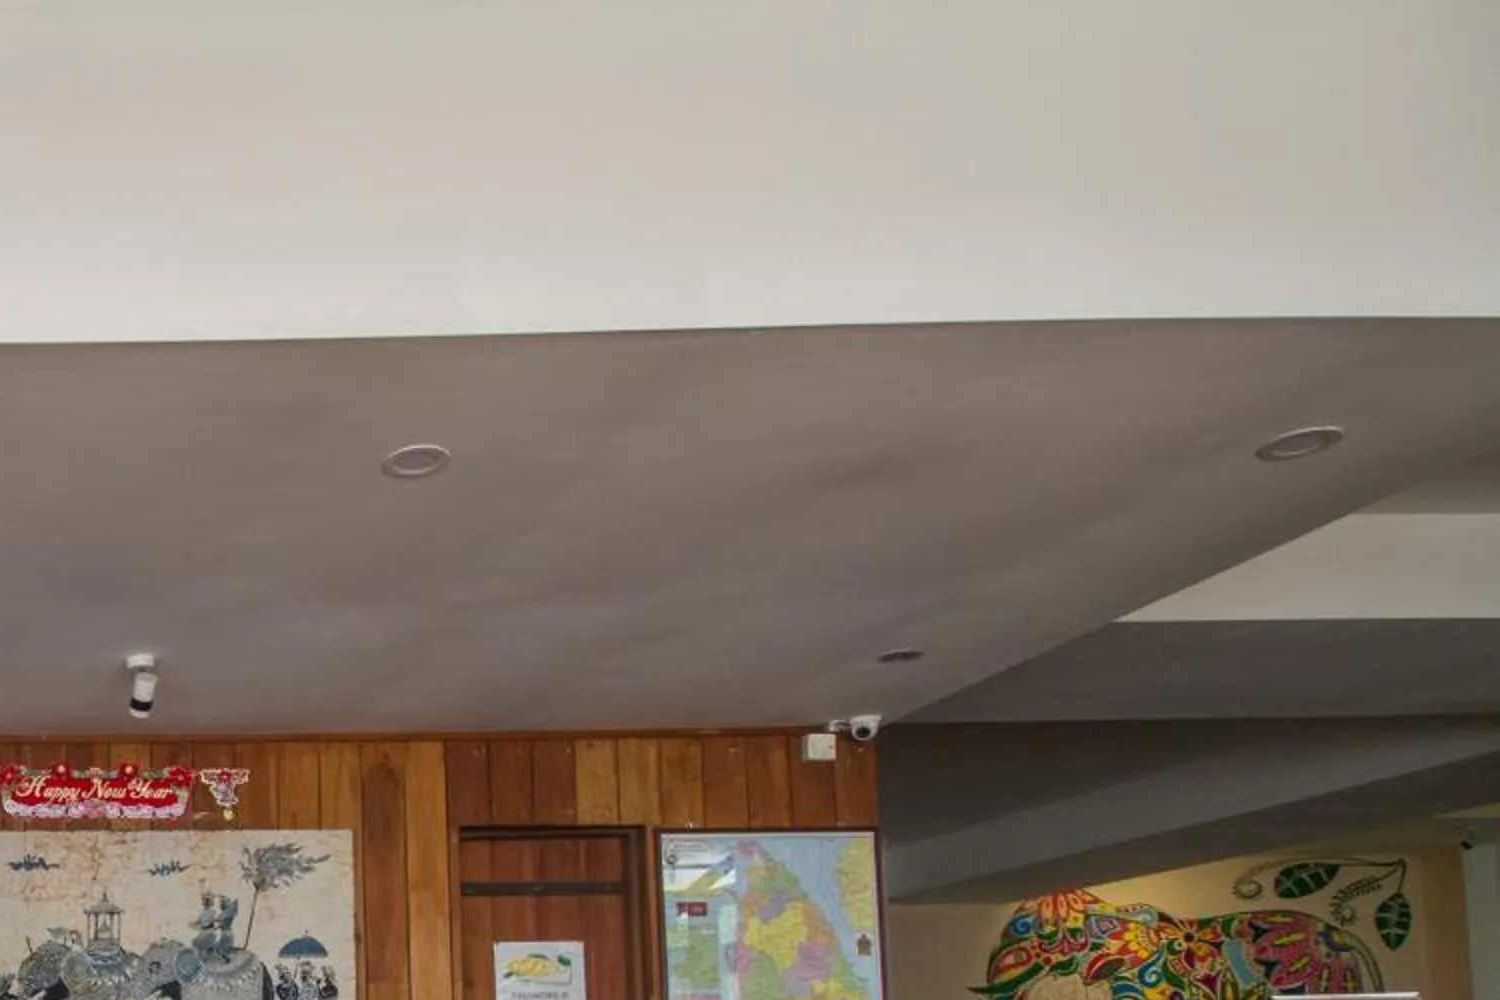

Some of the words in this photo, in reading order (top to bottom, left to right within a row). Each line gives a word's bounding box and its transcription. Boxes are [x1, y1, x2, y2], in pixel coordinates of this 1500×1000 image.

[15, 775, 80, 804] Happy
[82, 777, 127, 799] New
[127, 777, 173, 799] Year
